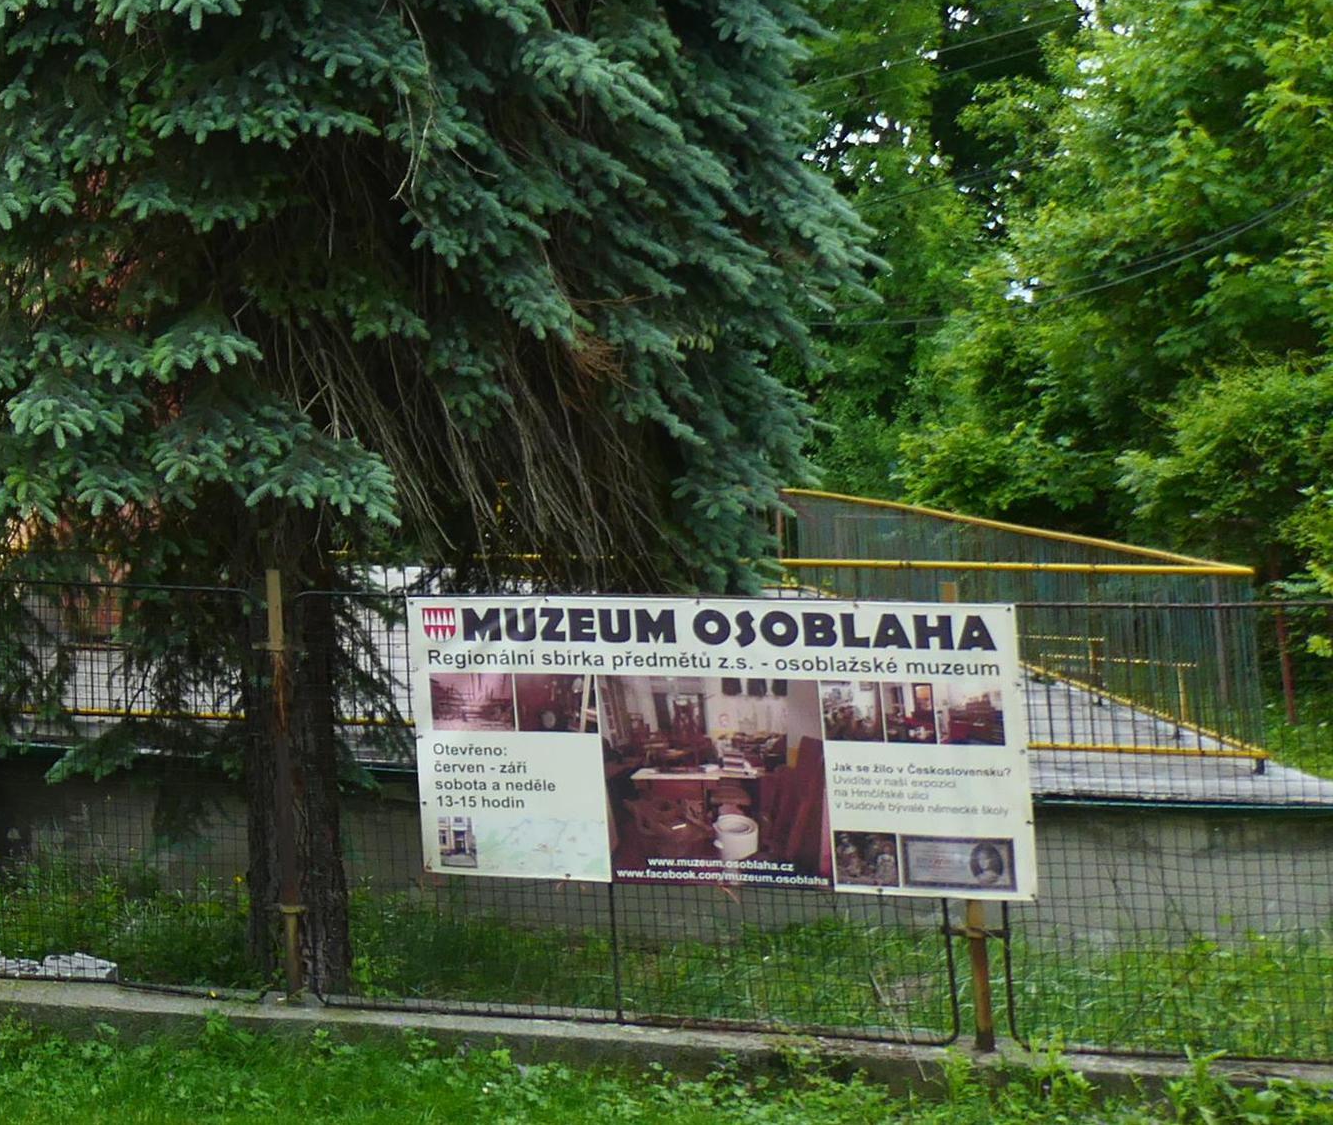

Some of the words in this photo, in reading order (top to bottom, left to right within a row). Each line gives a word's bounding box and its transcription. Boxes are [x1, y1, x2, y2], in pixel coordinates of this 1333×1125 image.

[461, 607, 677, 644] MUZEUM
[692, 608, 998, 651] OSOBLAHA
[427, 649, 534, 669] Regionální
[541, 649, 604, 667] sbírka
[612, 651, 711, 670] předmětů
[718, 656, 753, 670] z.s.
[775, 655, 897, 674] osoblažské
[906, 660, 1000, 676] muzeum
[433, 743, 507, 756] Otevřeno:
[434, 760, 485, 773] červen
[499, 761, 527, 774] září
[832, 763, 853, 772] Jak
[856, 765, 870, 773] se
[873, 763, 894, 774] žilo
[896, 766, 904, 774] v
[907, 763, 1012, 777] Československu?
[435, 778, 487, 791] sobota
[492, 782, 500, 791] a
[505, 779, 556, 792] neděle
[436, 795, 477, 808] 13-15
[481, 796, 525, 808] hodin
[648, 857, 795, 872] www.muzeum.osoblaha.cz
[616, 869, 829, 886] www.facebook.com/muzeum.osoblaha
